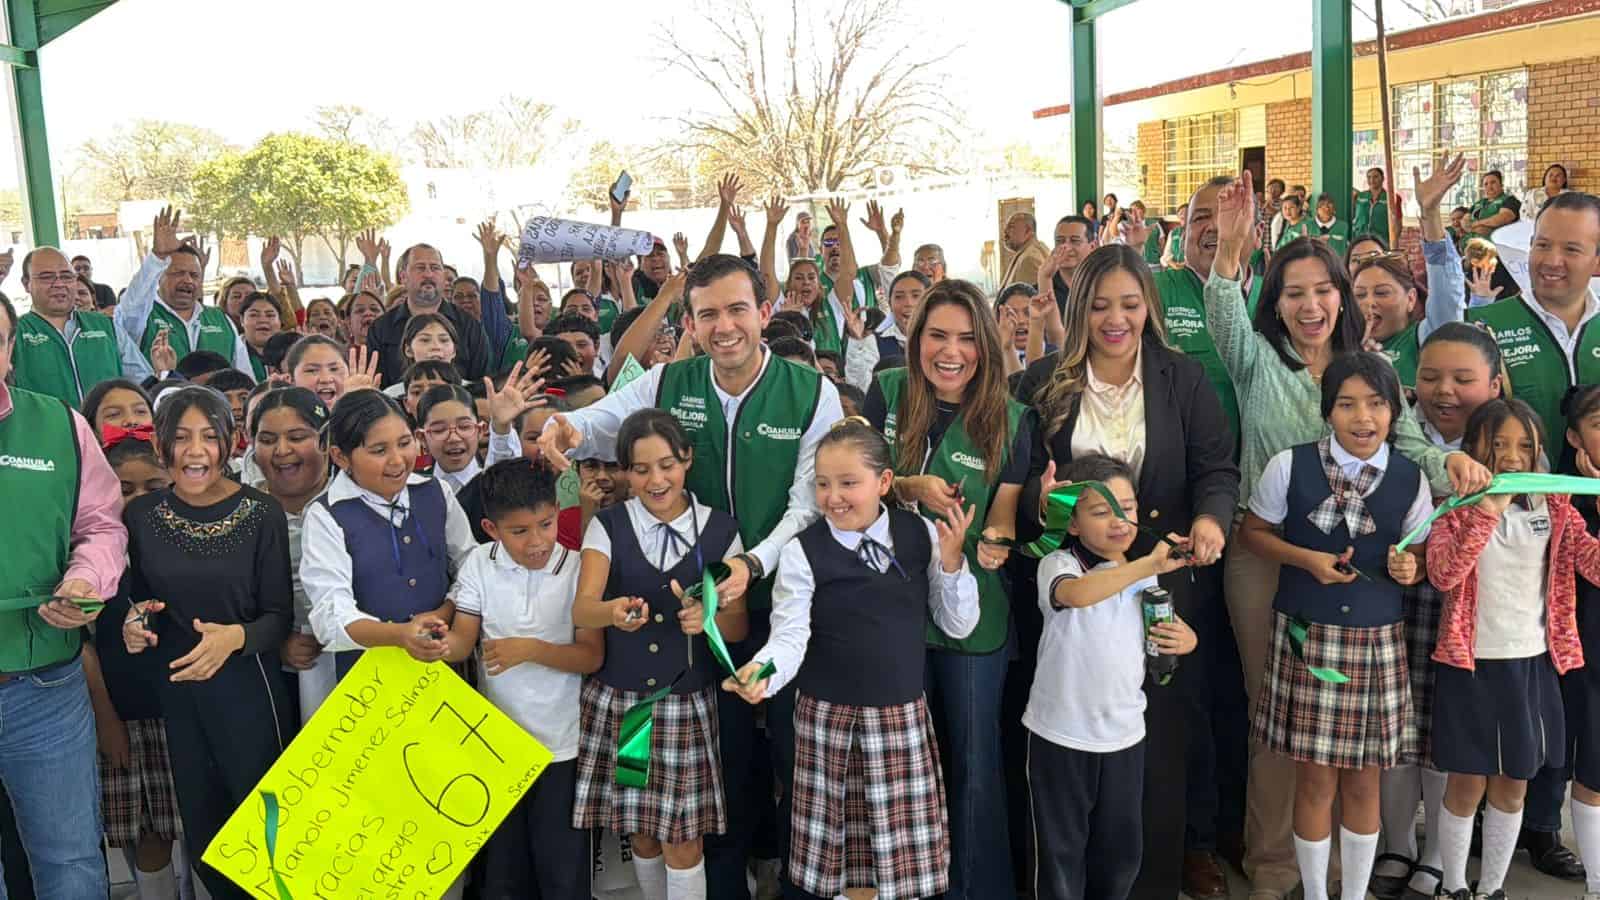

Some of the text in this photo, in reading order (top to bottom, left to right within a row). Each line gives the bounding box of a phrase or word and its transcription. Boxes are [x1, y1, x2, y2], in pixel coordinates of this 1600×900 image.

[1497, 326, 1532, 339] ARLOS
[1500, 343, 1541, 357] EJORA
[756, 423, 802, 436] COAHUILA
[331, 726, 391, 809] Jimenez
[464, 762, 542, 852] Six Seven
[218, 829, 259, 875] Sr
[372, 820, 419, 884] apoyo
